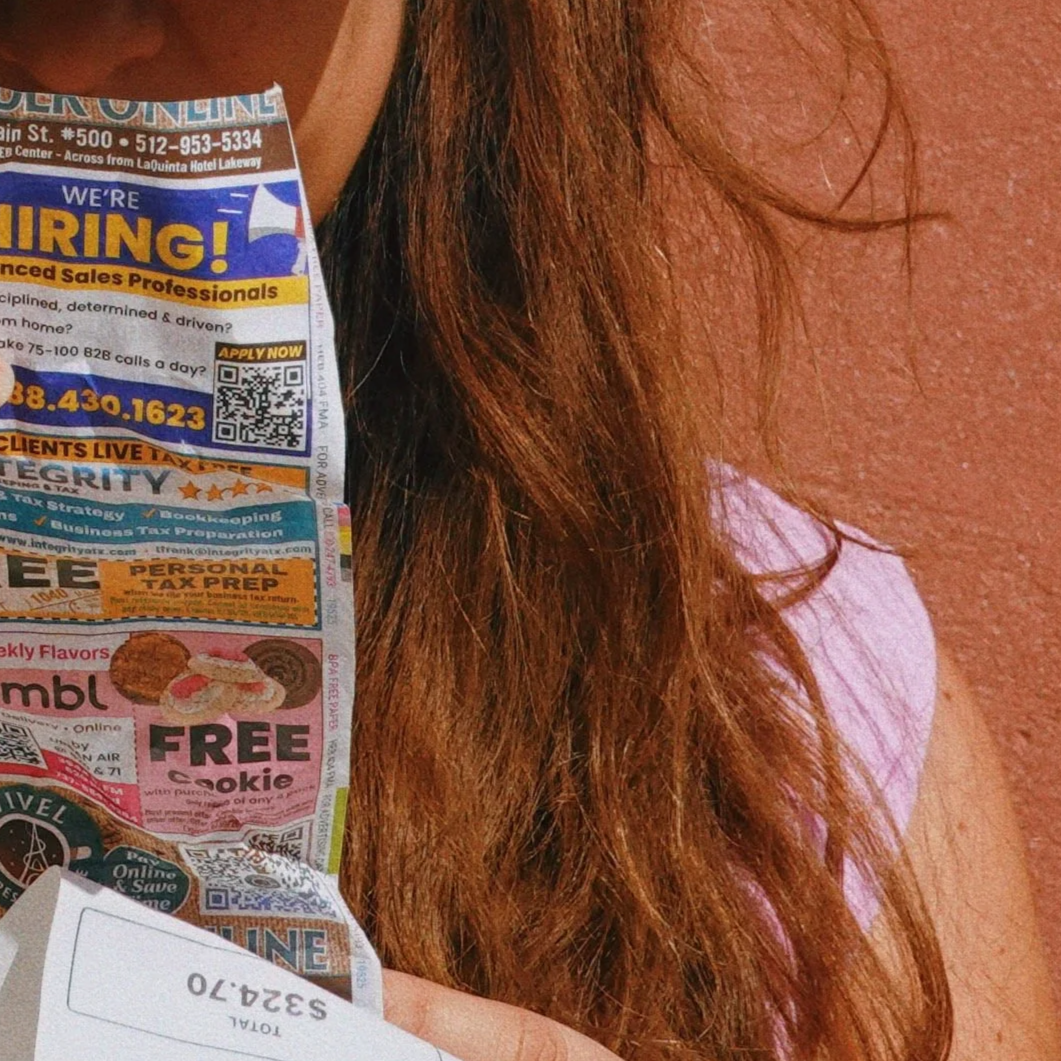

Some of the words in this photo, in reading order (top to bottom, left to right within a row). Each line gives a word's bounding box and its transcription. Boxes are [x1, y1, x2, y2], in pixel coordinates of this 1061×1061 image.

[27, 124, 54, 144] St.
[60, 126, 113, 149] #500
[135, 129, 263, 155] 512-953-5334
[15, 145, 52, 159] Center
[64, 150, 104, 165] Across
[106, 154, 135, 168] from
[137, 157, 188, 173] LaQuinta
[190, 159, 217, 173] Hotel
[218, 156, 263, 171] Lakeway
[61, 184, 140, 210] WE'RE
[60, 268, 123, 285] Sales
[128, 273, 278, 303] Professionals
[21, 317, 73, 335] home?
[66, 301, 158, 320] determined
[162, 313, 171, 323] &
[175, 316, 233, 334] driven?
[28, 342, 79, 356] 75-100
[84, 348, 111, 361] B2B
[115, 353, 151, 368] calls
[155, 360, 165, 369] a
[169, 362, 207, 378] day?
[218, 346, 268, 359] APPLY
[267, 345, 304, 358] NOW
[7, 381, 206, 431] 88.430.1623
[318, 400, 329, 429] FMA
[93, 442, 143, 461] LIVE
[149, 446, 191, 472] TAX
[317, 446, 329, 468] FOR
[55, 485, 79, 495] TAX
[12, 493, 44, 509] Tax
[46, 501, 125, 521] Strategy
[159, 510, 283, 526] Bookkeeping
[50, 519, 133, 538] Business
[136, 526, 171, 536] Tax
[174, 526, 284, 540] Preparation
[129, 562, 288, 577] PERSONAL
[141, 577, 196, 591] TAX
[203, 577, 279, 592] PREP
[39, 643, 110, 660] Flavors
[328, 654, 339, 675] BPA
[328, 678, 339, 700] FREE
[328, 702, 339, 732] PAPER
[73, 723, 122, 735] Online
[149, 721, 311, 766] FREE
[97, 752, 120, 762] AIR
[144, 788, 171, 797] with
[126, 850, 160, 866] Pay
[112, 864, 177, 880] Online
[131, 879, 178, 893] Save
[187, 971, 327, 1021] $324.70
[228, 1015, 282, 1037] TOTAL
